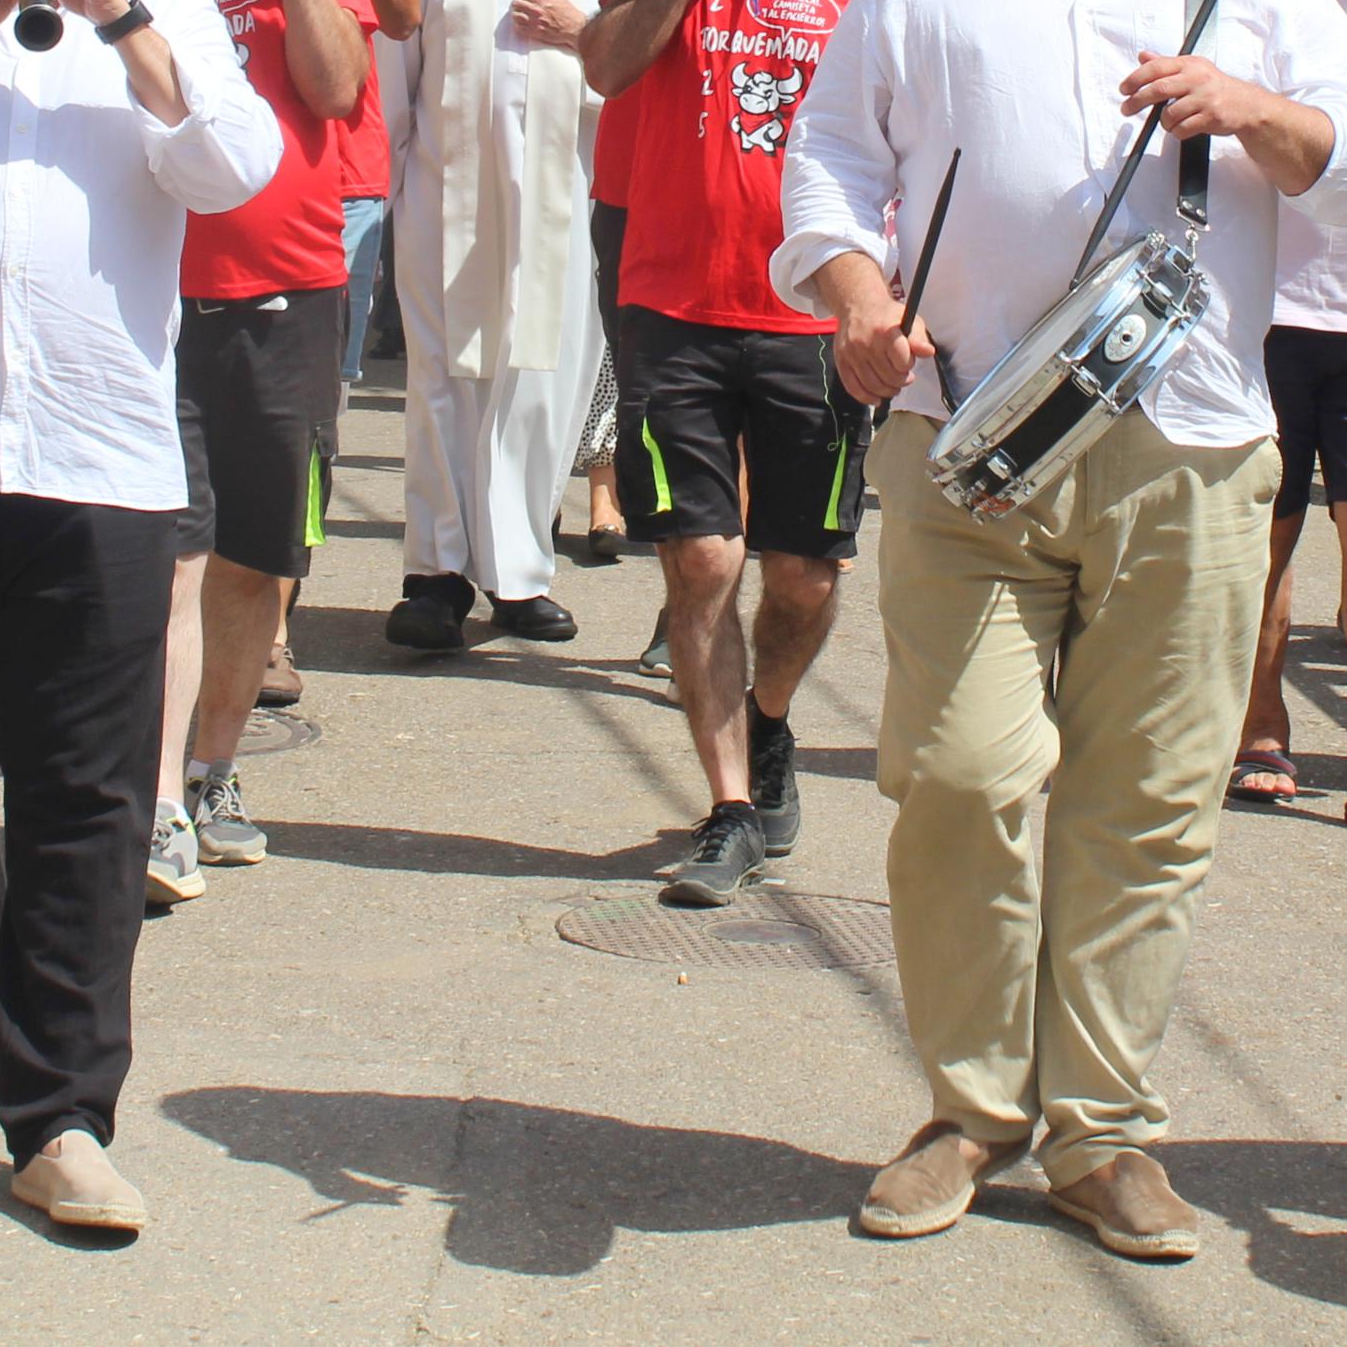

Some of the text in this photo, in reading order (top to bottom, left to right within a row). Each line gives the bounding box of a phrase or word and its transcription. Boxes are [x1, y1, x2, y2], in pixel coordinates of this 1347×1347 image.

[768, 9, 779, 19] AL
[773, 0, 816, 15] CAMISETA
[701, 27, 820, 64] TORQUEMADA
[701, 69, 714, 95] 2
